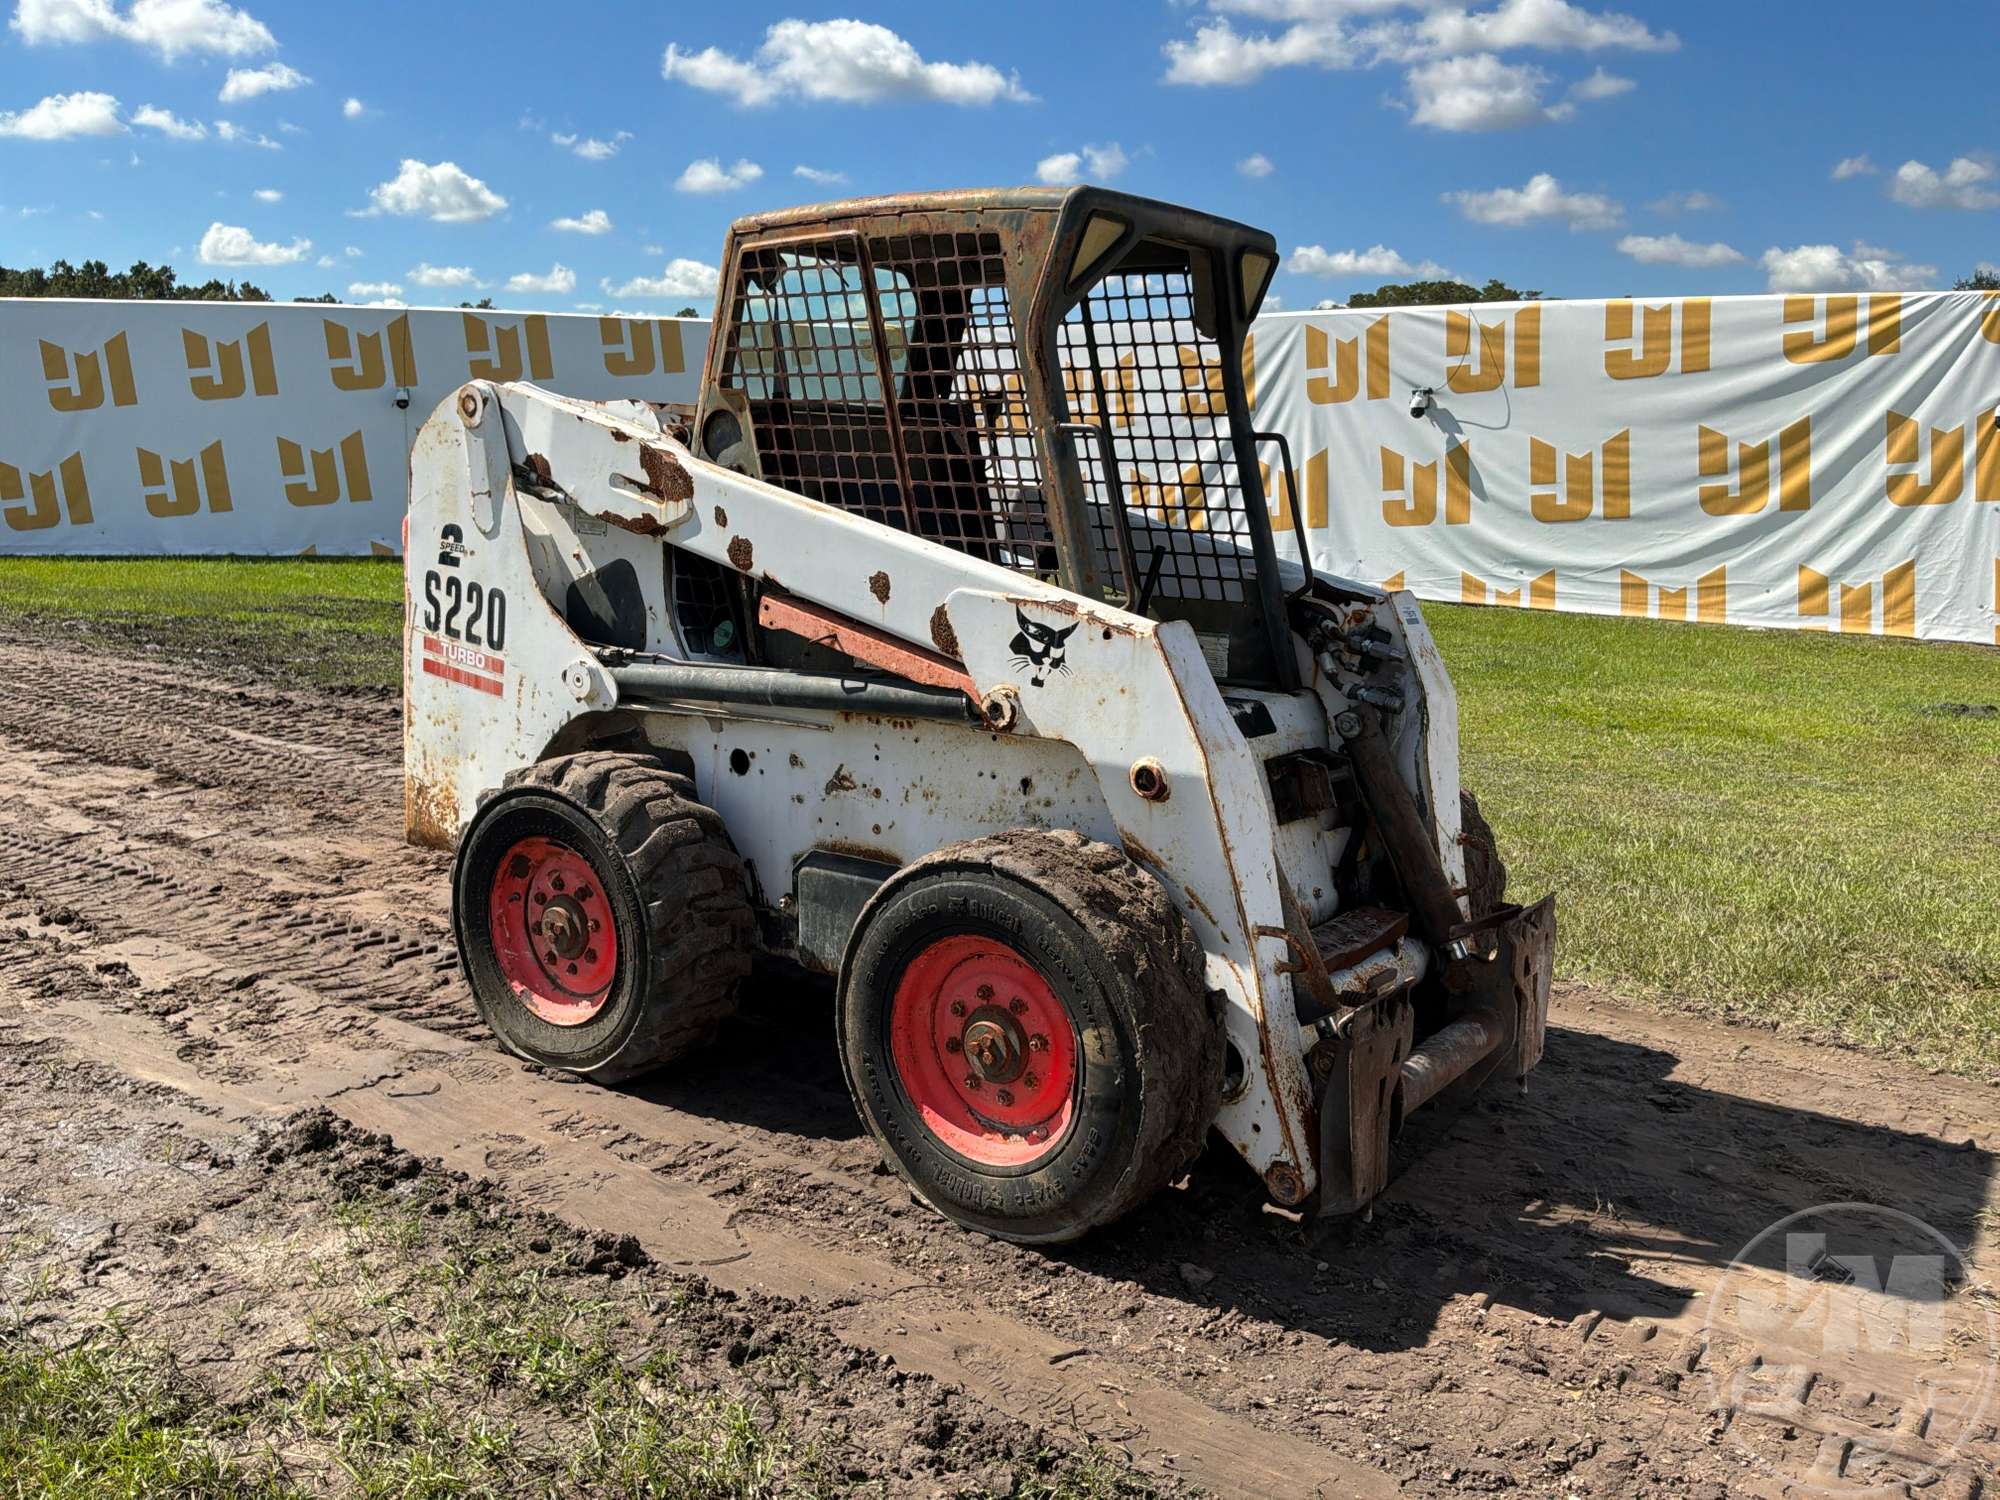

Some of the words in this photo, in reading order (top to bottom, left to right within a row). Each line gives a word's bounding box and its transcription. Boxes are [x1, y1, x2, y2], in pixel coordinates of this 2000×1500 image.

[438, 523, 463, 568] 2
[440, 541, 465, 553] SPEED
[424, 570, 506, 651] S220
[441, 643, 485, 668] TURBO
